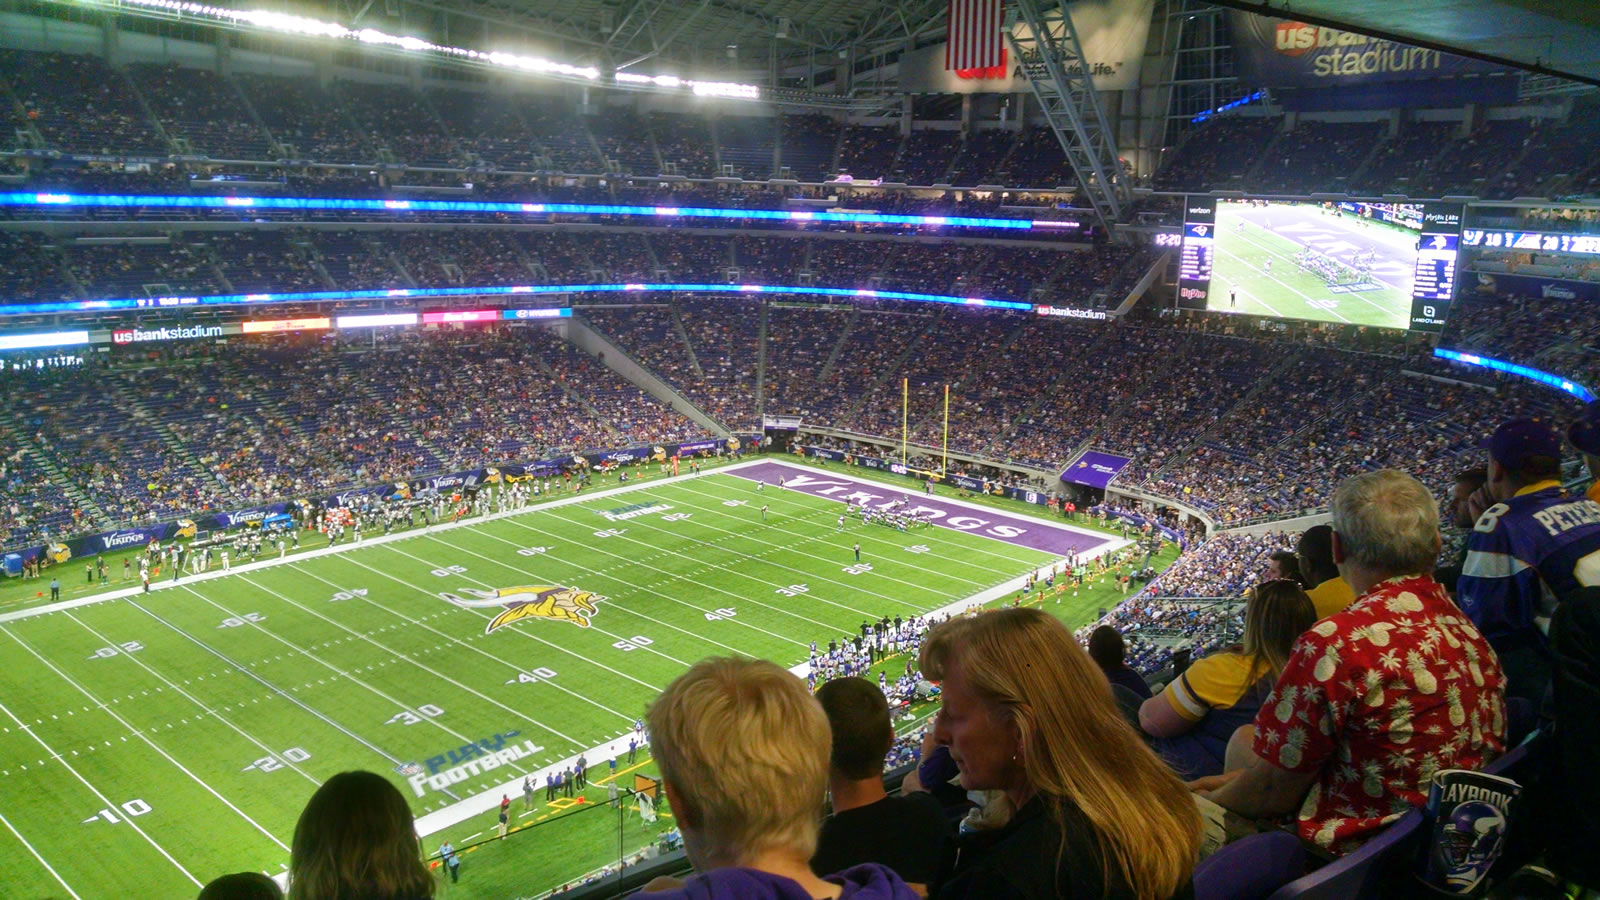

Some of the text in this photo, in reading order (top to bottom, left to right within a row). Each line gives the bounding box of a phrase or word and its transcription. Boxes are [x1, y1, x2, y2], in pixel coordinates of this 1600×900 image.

[1313, 46, 1441, 76] stadium
[1473, 502, 1511, 534] 8
[704, 608, 737, 622] 40
[611, 635, 654, 652] 50
[516, 665, 559, 685] 40
[402, 703, 445, 726] 30
[255, 746, 313, 776] 20
[407, 739, 545, 798] FOOTBALL
[425, 733, 509, 776] PLAY
[97, 798, 153, 826] 10
